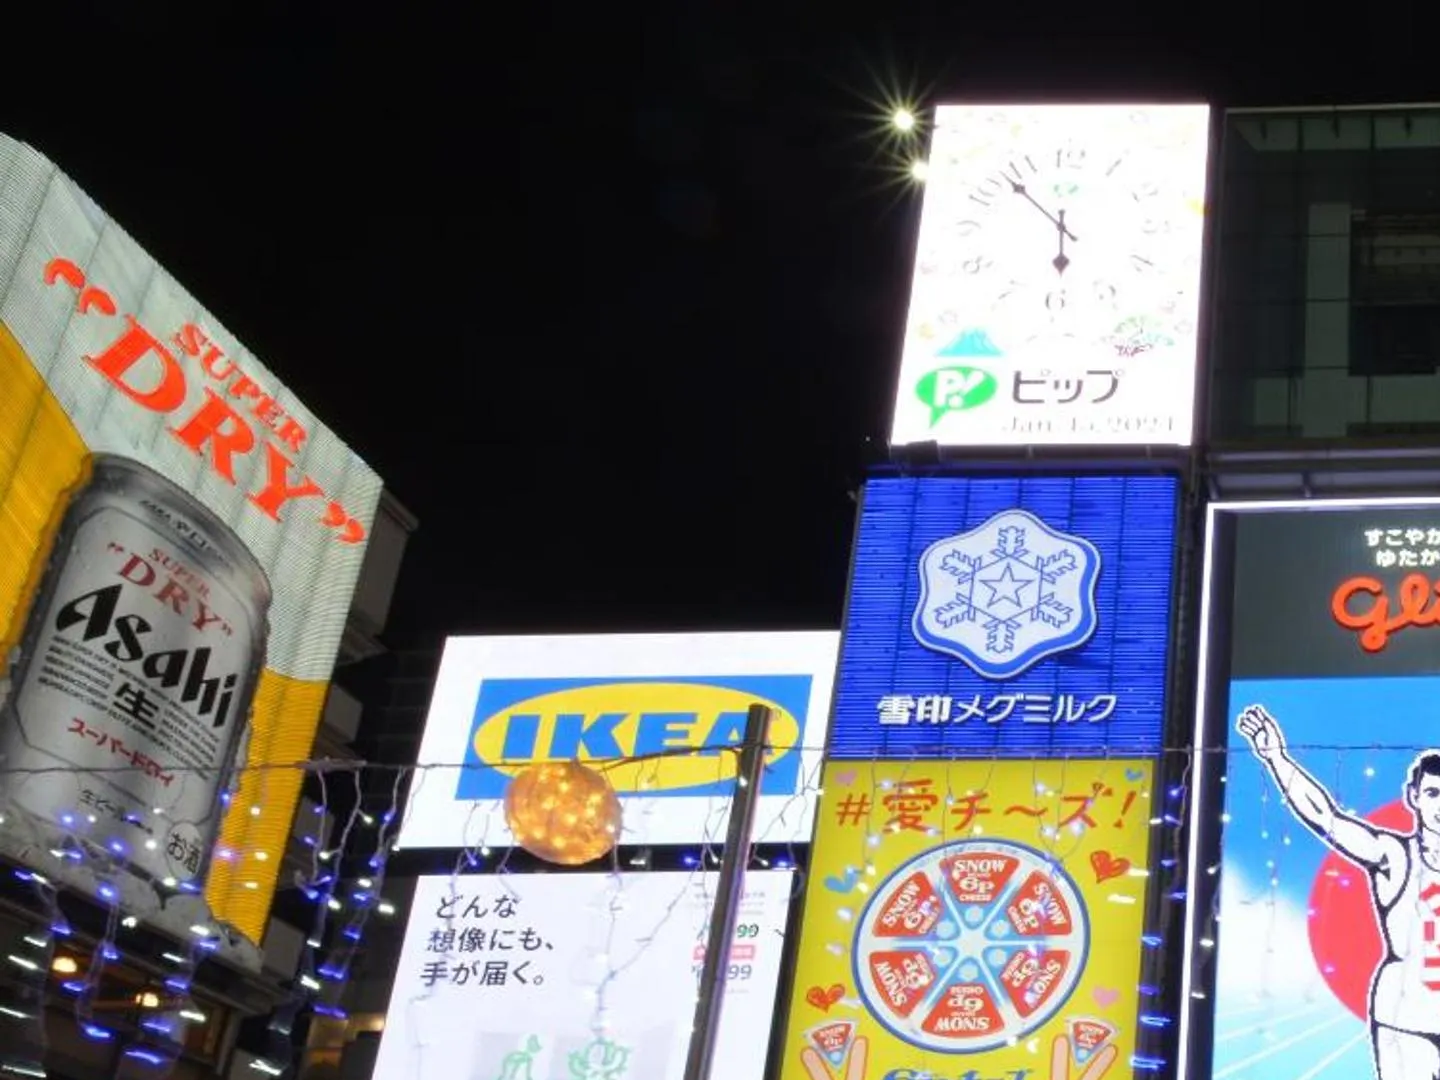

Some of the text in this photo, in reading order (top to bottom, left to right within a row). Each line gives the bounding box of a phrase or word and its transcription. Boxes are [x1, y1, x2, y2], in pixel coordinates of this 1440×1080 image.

[170, 322, 308, 456] SUPER
[1011, 369, 1123, 404] ピップ
[55, 583, 239, 728] Asahi
[112, 681, 161, 731] 生
[877, 693, 1118, 725] 雪印メグミルク
[500, 711, 775, 760] IKEA
[954, 859, 1008, 873] SNOW
[435, 895, 518, 919] どんな
[1024, 958, 1062, 1008] SNO
